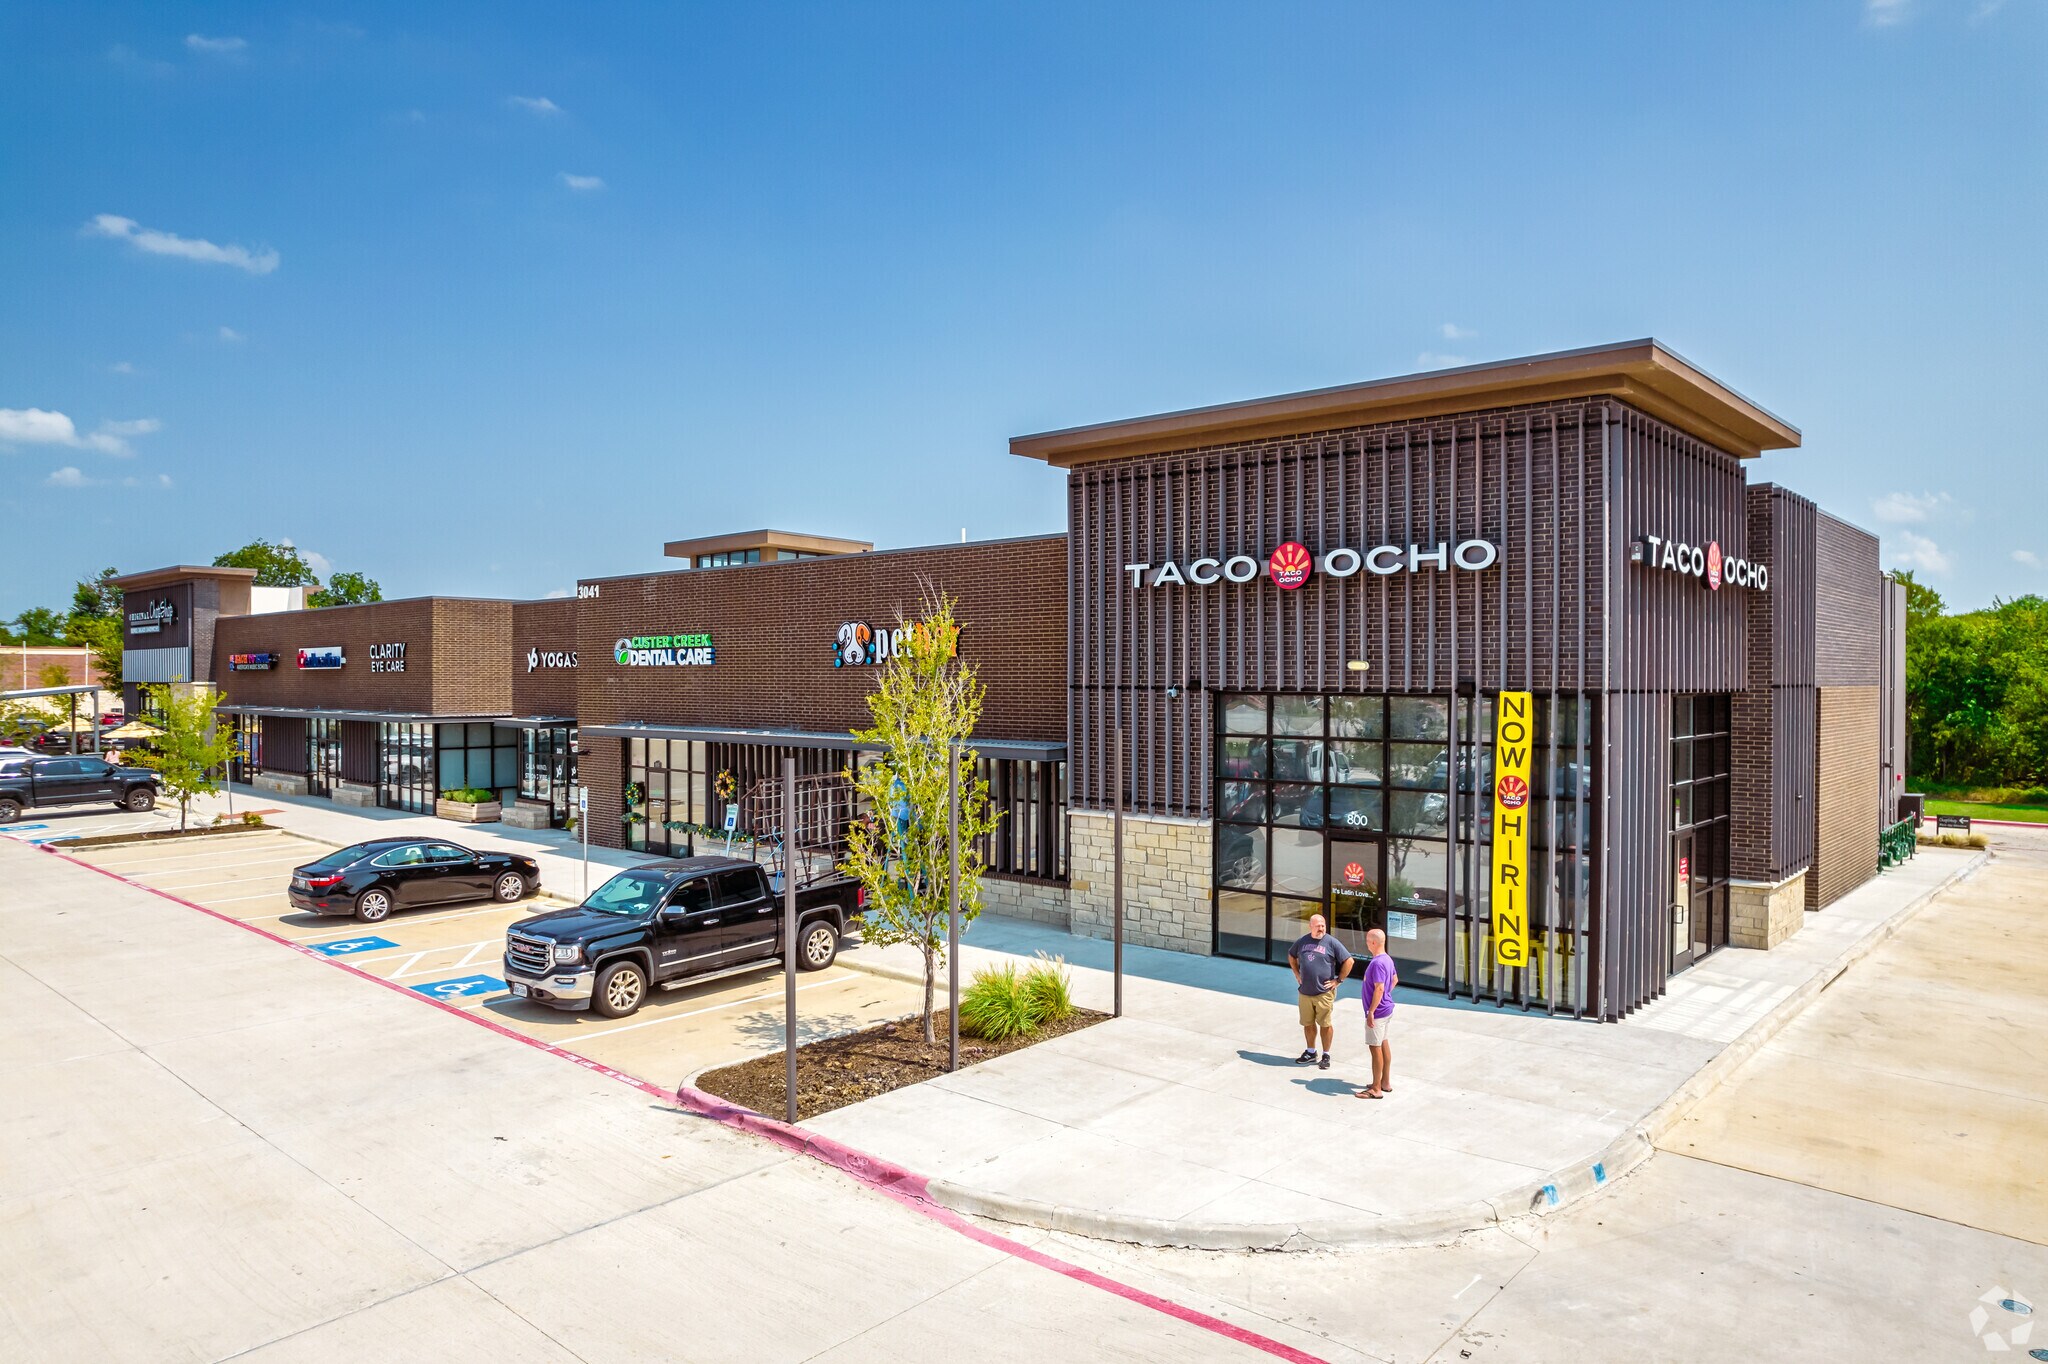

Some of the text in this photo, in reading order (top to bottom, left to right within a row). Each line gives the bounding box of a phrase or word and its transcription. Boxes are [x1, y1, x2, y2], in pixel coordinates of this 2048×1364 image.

[1125, 539, 1497, 588] TACO OCHO
[1648, 535, 1768, 591] TACO OCHO
[578, 585, 600, 599] 3041
[632, 634, 712, 648] CUSTER CREEK
[370, 643, 405, 659] CLARITY
[630, 648, 715, 666] DENTAL CARE
[371, 660, 405, 672] EYE CARE
[1500, 697, 1527, 768] NOW
[1347, 815, 1368, 826] 800
[1498, 814, 1522, 961] HIRING
